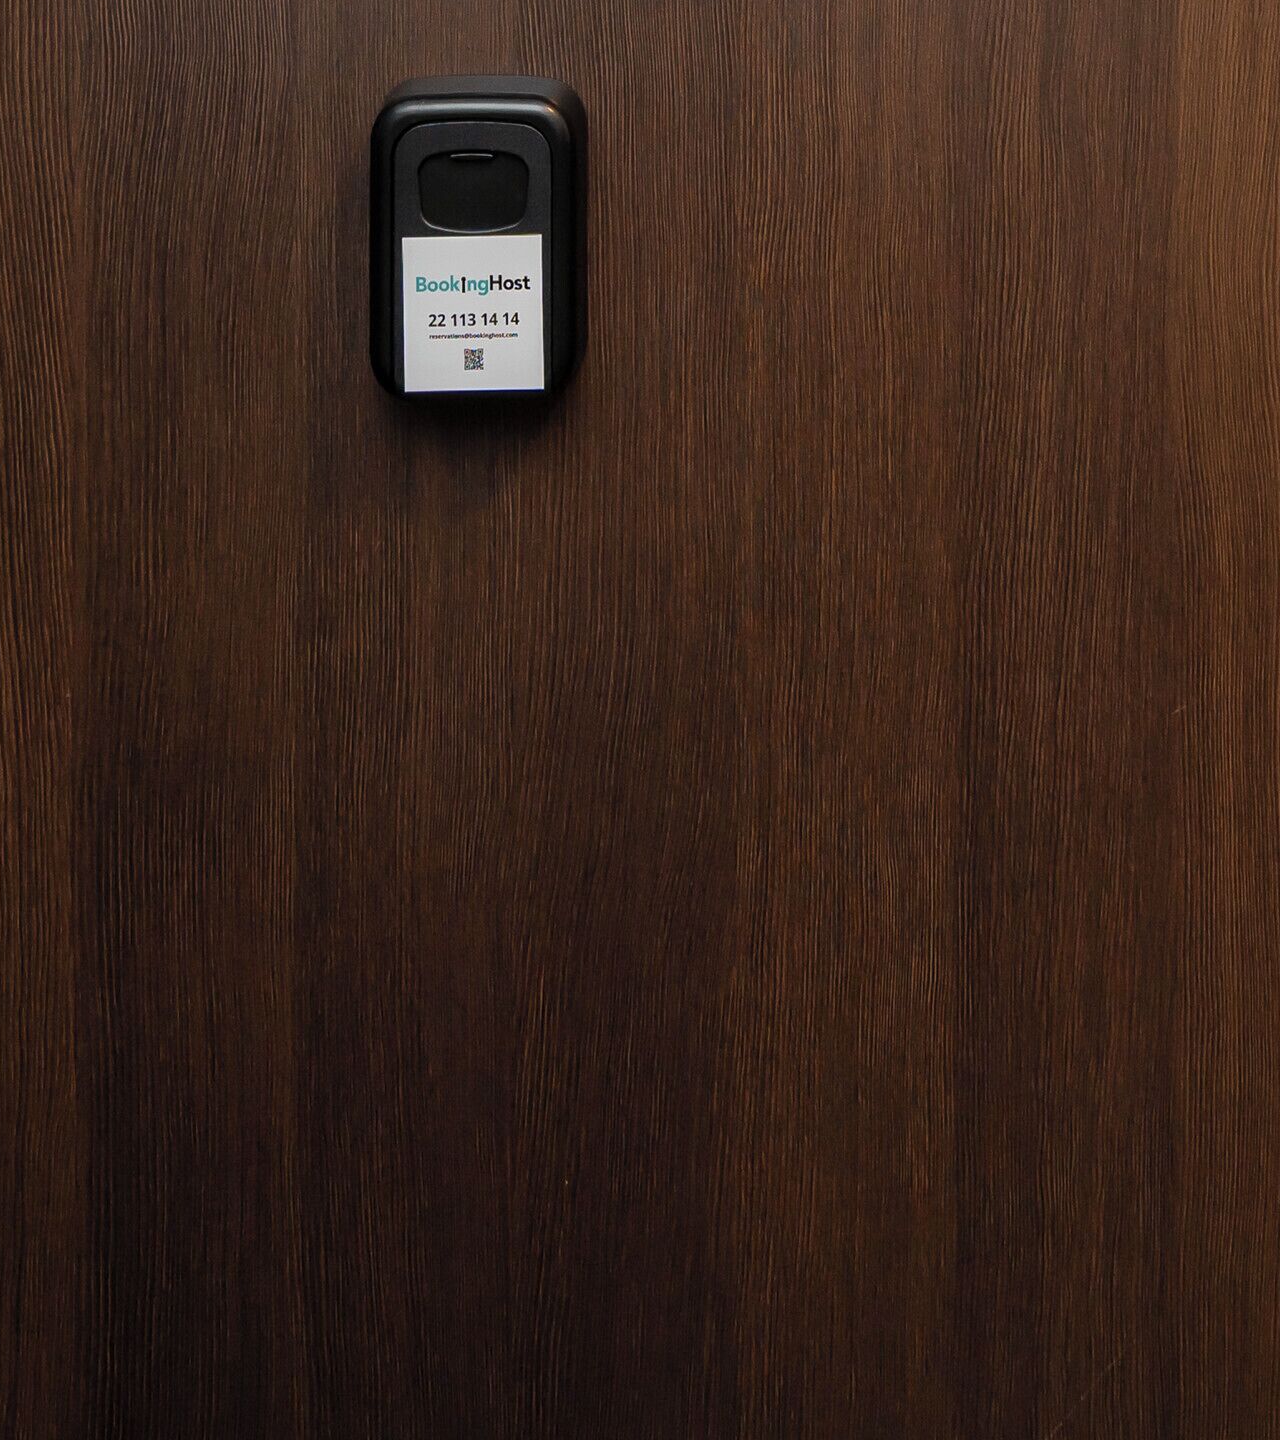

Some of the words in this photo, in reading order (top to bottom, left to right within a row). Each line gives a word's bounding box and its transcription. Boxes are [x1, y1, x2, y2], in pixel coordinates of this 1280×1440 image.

[428, 314, 446, 327] 22
[451, 313, 476, 326] 113
[481, 312, 498, 325] 14
[502, 312, 520, 325] 14
[429, 332, 518, 340] reservations@bookinghost.com
